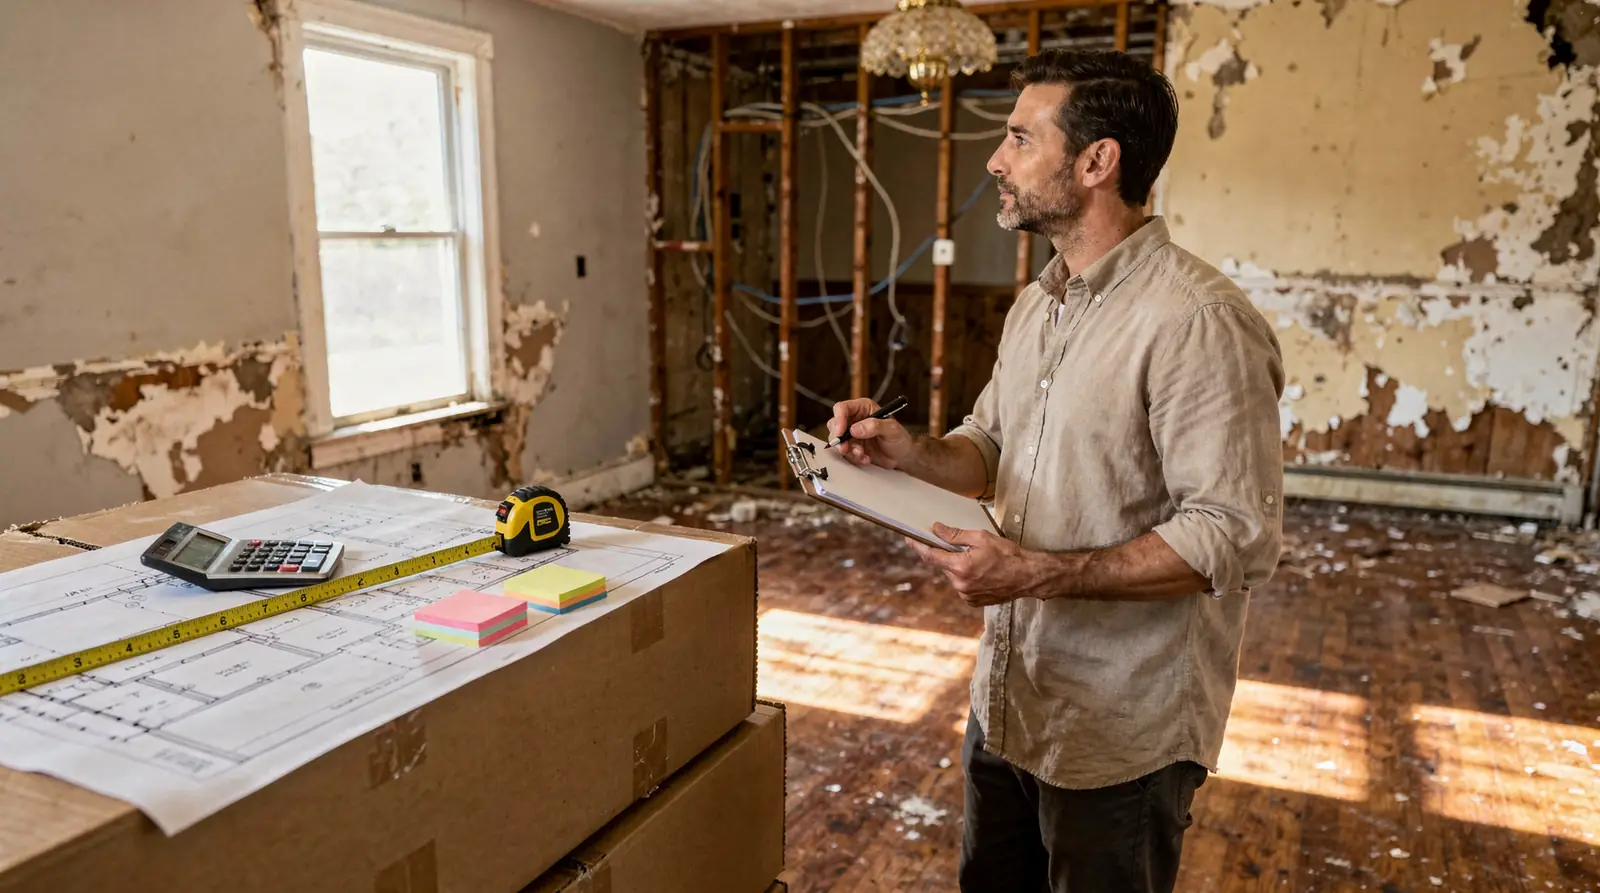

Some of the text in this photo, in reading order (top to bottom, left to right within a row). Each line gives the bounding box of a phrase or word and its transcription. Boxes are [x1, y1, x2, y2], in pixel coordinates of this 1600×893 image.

[18, 673, 26, 684] 2
[74, 657, 82, 668] 3
[173, 630, 181, 639] 5
[220, 616, 227, 625] 6
[262, 604, 268, 614] 7
